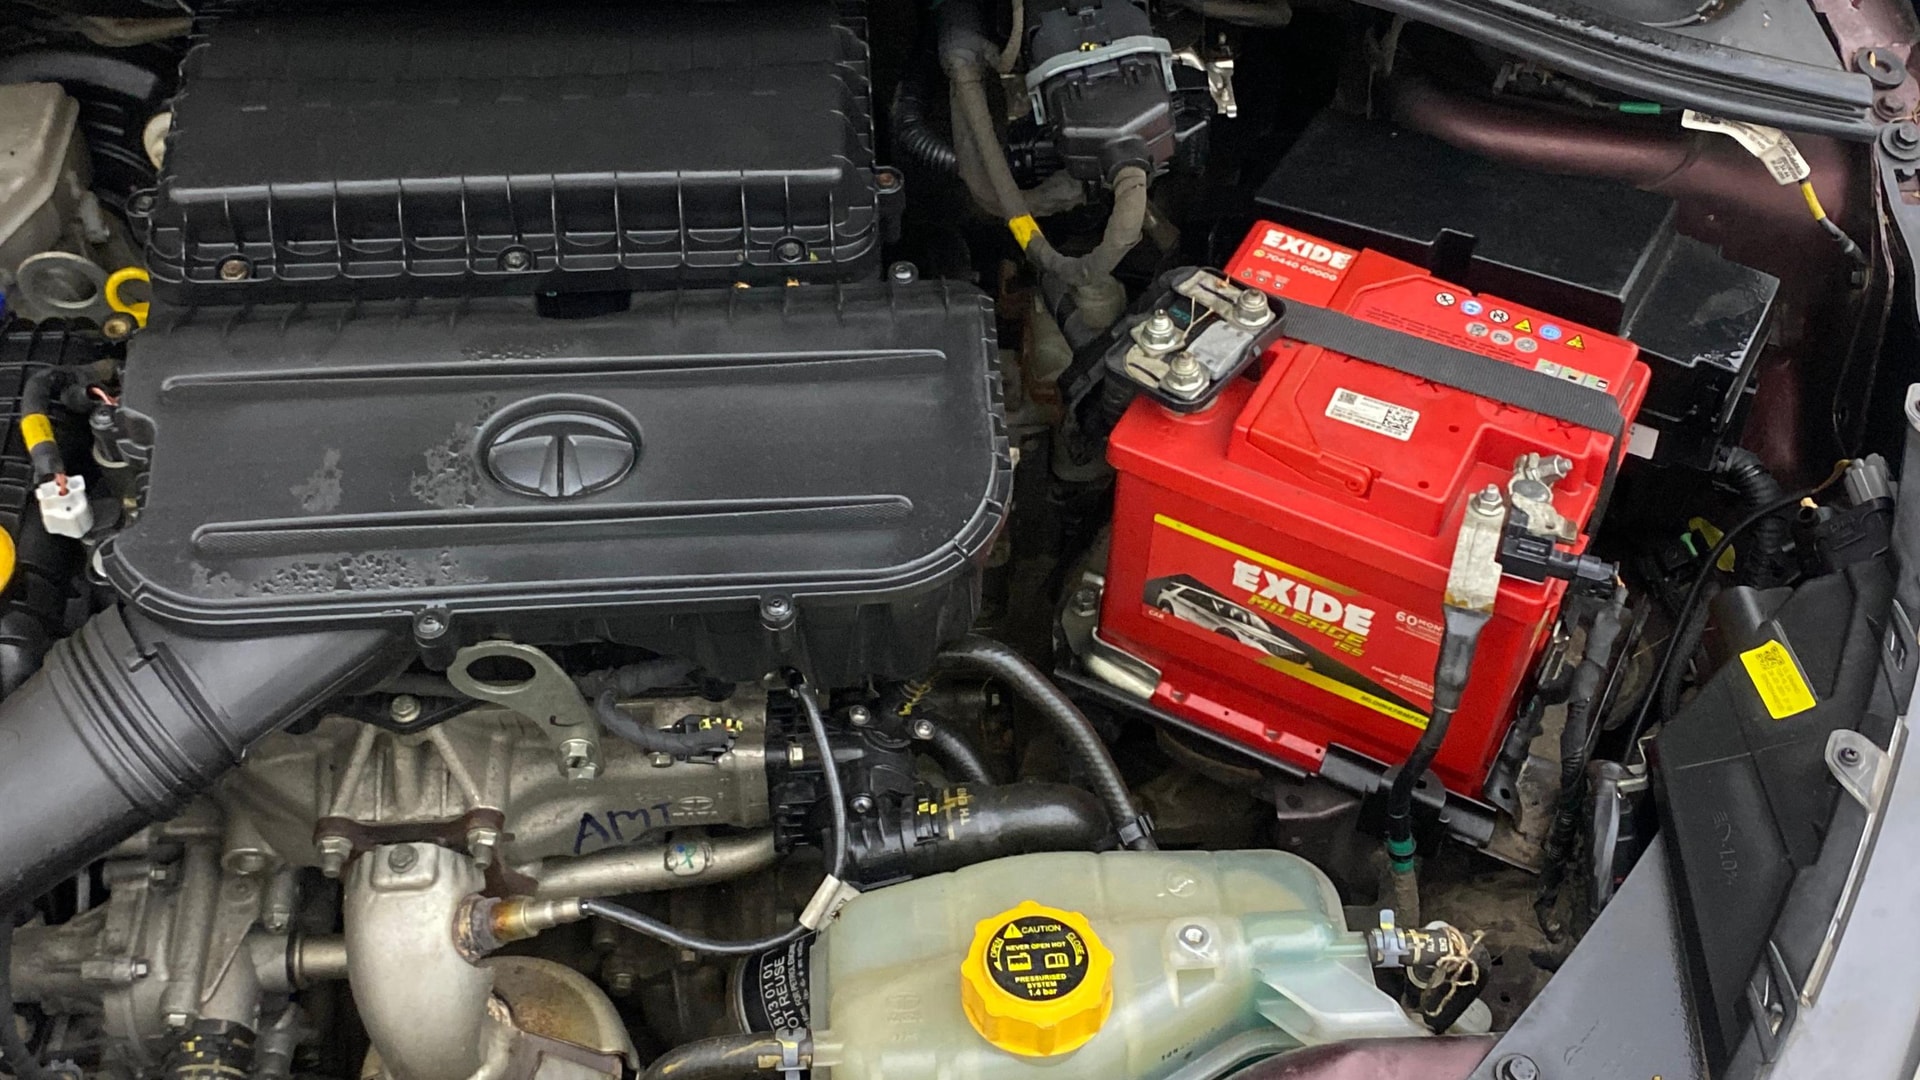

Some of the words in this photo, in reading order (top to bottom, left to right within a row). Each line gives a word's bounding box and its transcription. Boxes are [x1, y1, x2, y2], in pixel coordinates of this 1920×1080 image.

[1262, 229, 1353, 270] EXIDE
[1265, 252, 1299, 269] 70440
[1300, 264, 1338, 282] 00000
[1232, 559, 1376, 637] EXIDE
[1248, 594, 1368, 647] MILEAGE
[1395, 611, 1418, 626] 60
[573, 802, 673, 854] AMT
[1021, 924, 1061, 934] CAUTION
[990, 937, 1003, 958] OPEN
[1005, 943, 1030, 951] NEVER
[1066, 932, 1085, 956] CLOSE
[763, 963, 773, 979] 01
[1014, 973, 1067, 983] PRESSURISED
[764, 982, 776, 999] 01
[774, 956, 791, 1007] REUSE
[1026, 981, 1058, 989] SYSTEM
[782, 1010, 800, 1030] OT
